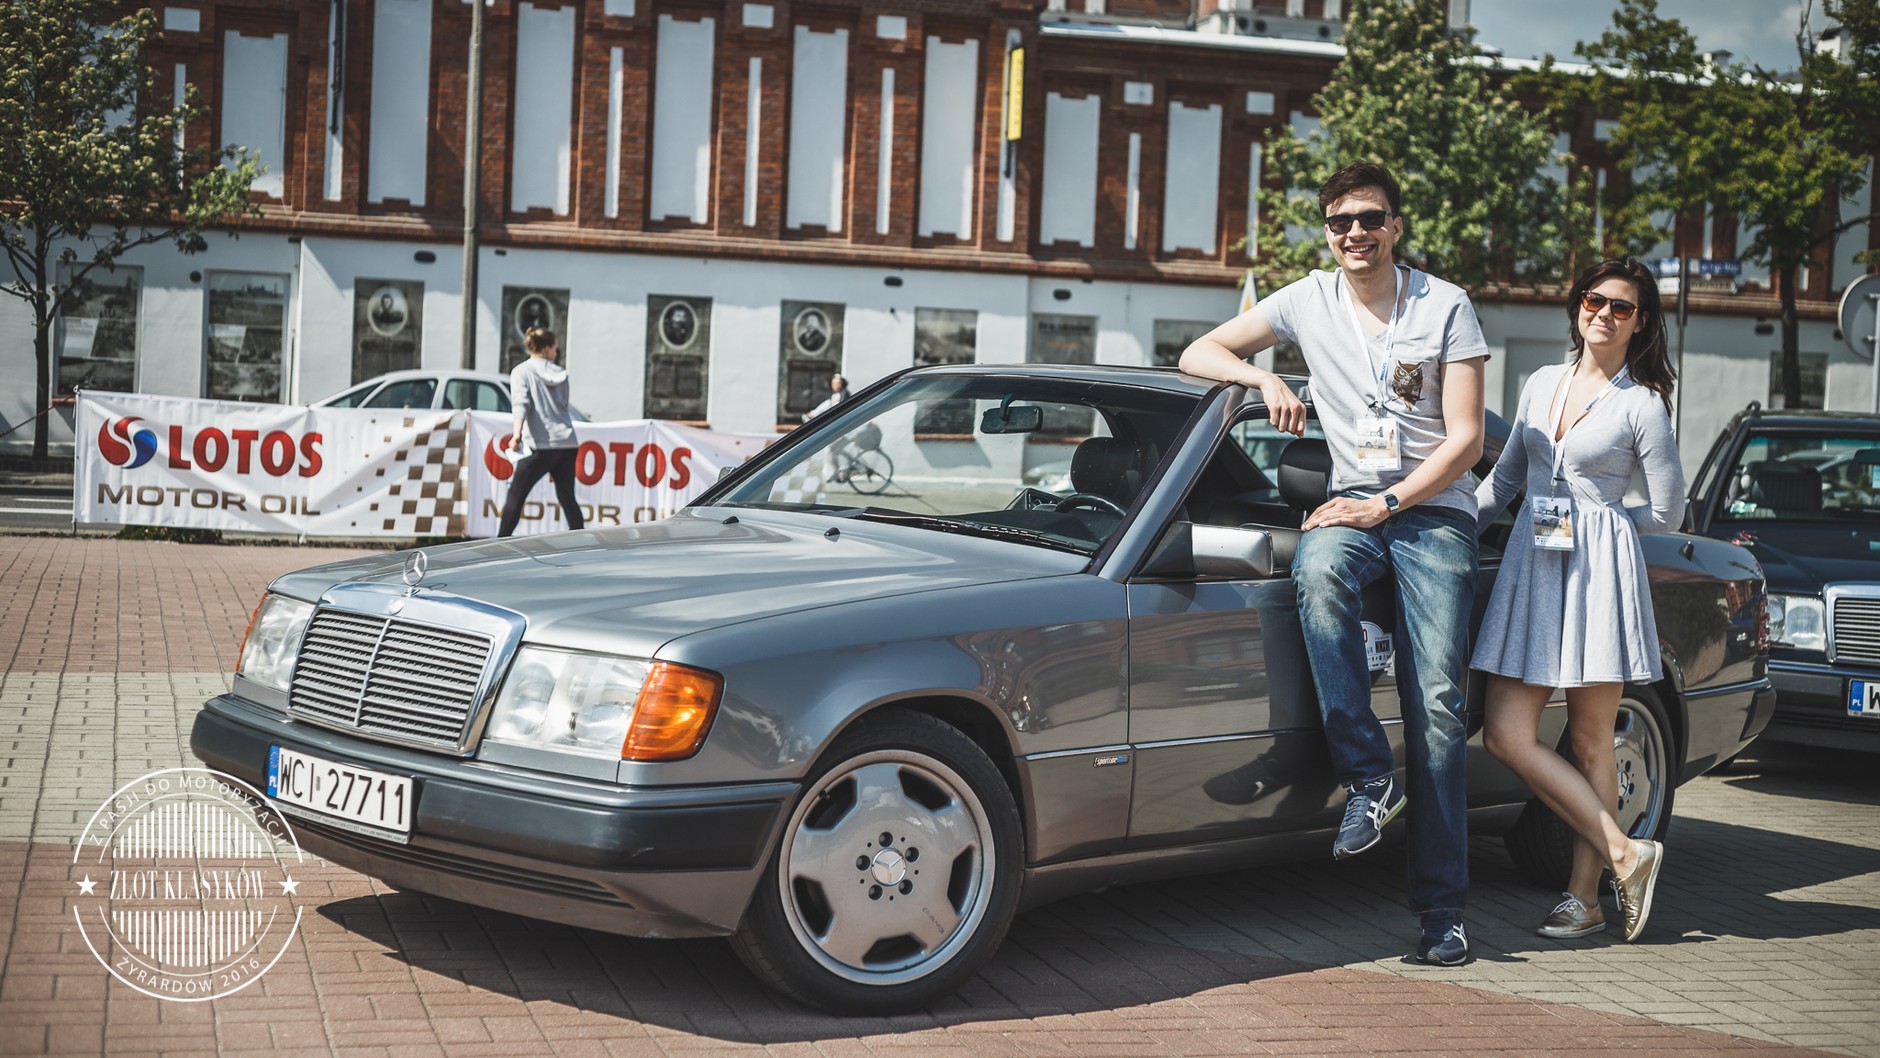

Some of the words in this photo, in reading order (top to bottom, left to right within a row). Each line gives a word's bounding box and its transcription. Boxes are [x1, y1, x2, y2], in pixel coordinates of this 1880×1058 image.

[168, 425, 323, 478] LOTOS
[574, 439, 692, 490] OTOS
[98, 483, 247, 512] MOTOR
[260, 494, 321, 516] OIL
[1852, 698, 1861, 707] PL
[269, 775, 277, 788] PL
[326, 768, 404, 825] 27711
